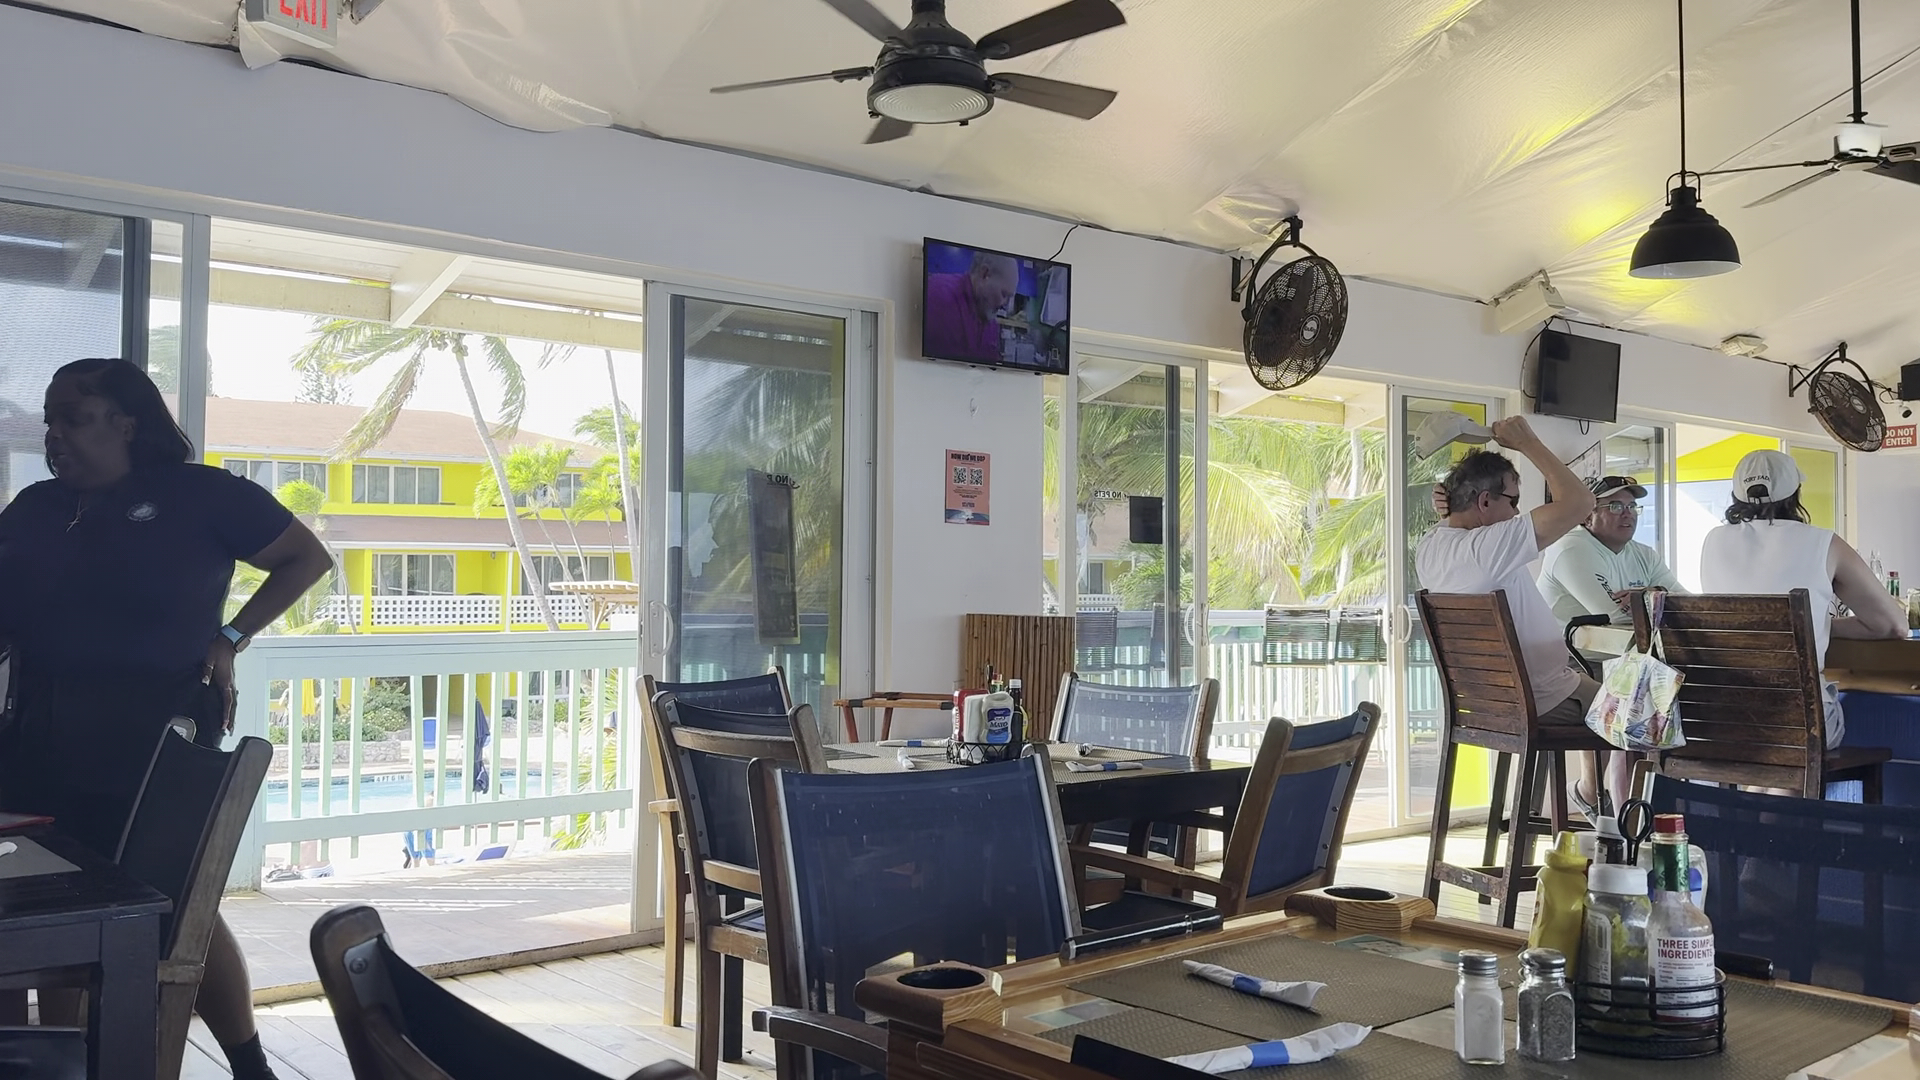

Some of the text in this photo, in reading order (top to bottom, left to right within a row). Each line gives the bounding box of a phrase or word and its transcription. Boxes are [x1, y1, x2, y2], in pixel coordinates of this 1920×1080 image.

[1897, 427, 1915, 437] NOT
[1886, 437, 1913, 447] ENTER
[1657, 938, 1688, 949] THREE
[1658, 948, 1713, 960] INGREDIENTS
